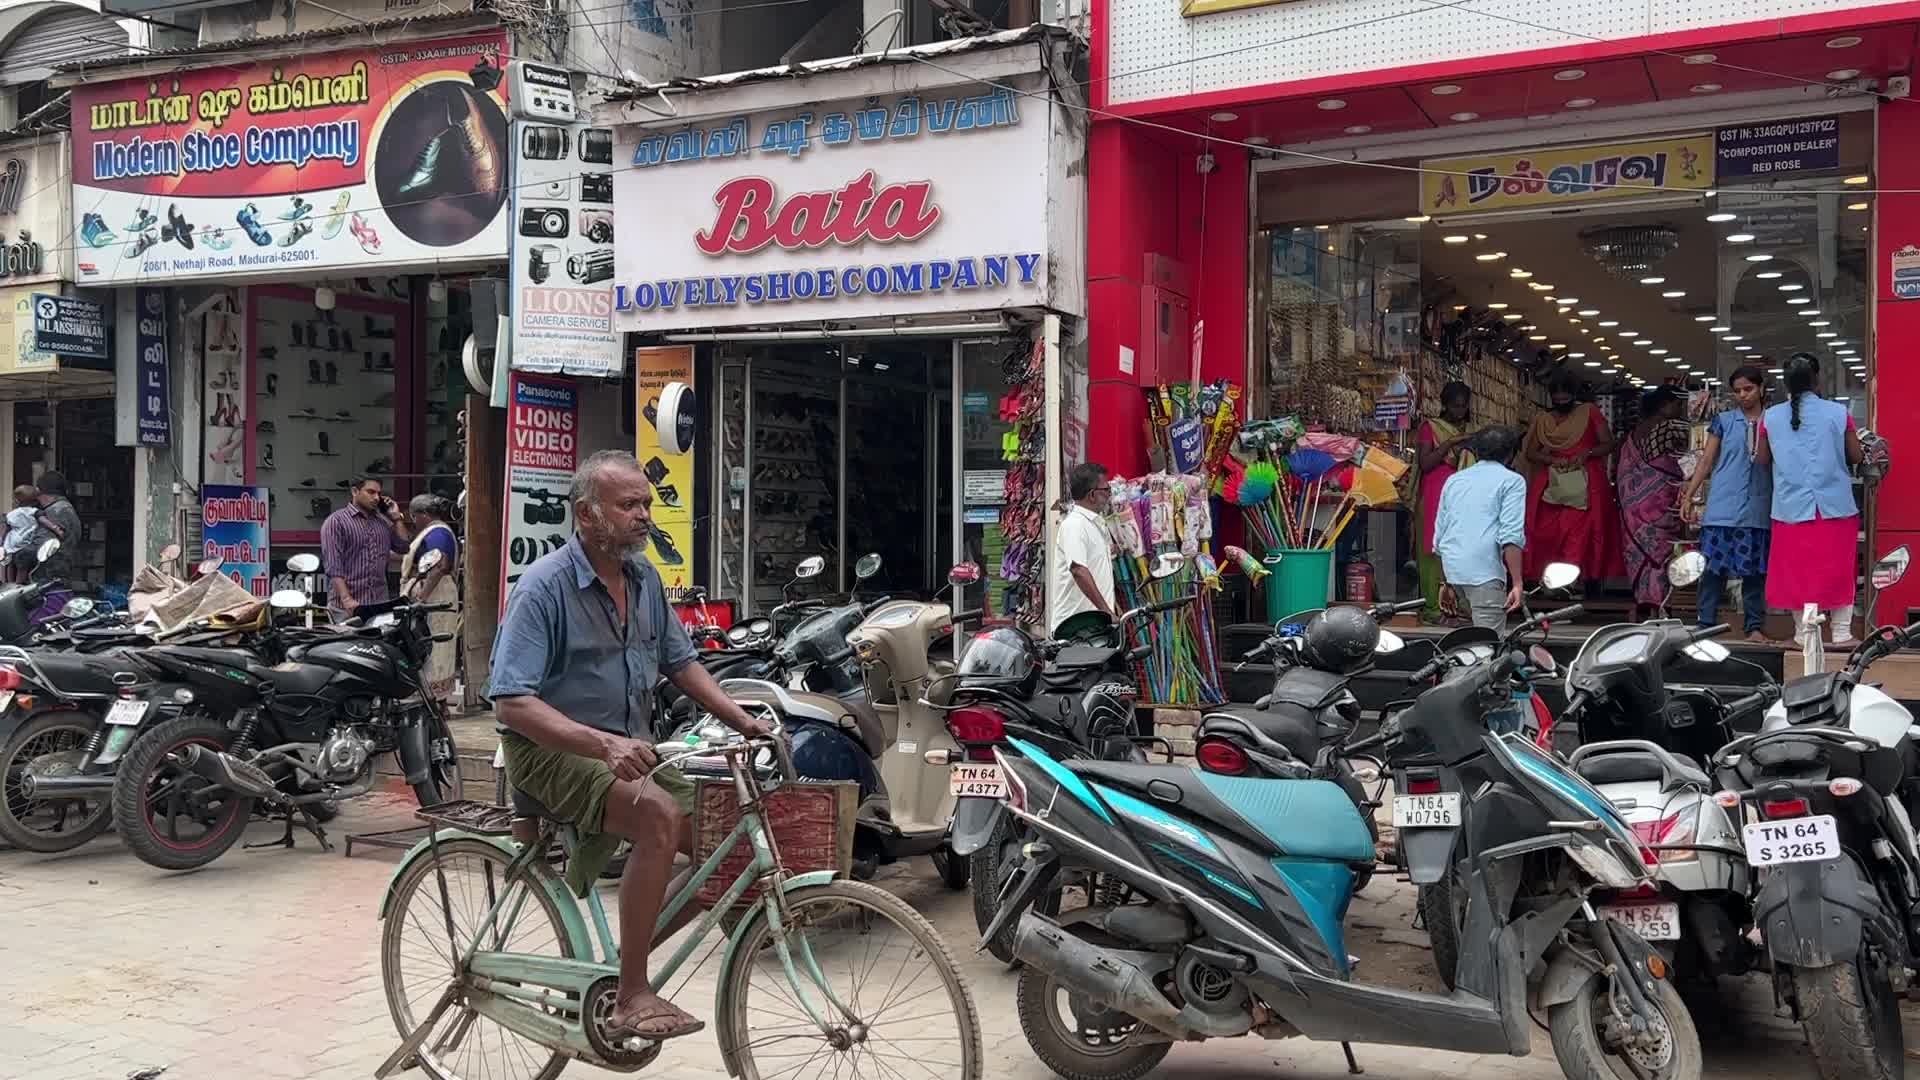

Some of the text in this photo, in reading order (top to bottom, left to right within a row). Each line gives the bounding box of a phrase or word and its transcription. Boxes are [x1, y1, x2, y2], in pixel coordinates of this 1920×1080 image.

[381, 53, 410, 65] GSTIN
[248, 60, 368, 115] கம்பெனி
[1720, 129, 1738, 141] GST
[94, 120, 360, 180] Modern Shoe Company
[1752, 159, 1801, 173] RED ROSE
[694, 169, 942, 256] Bata
[173, 259, 206, 271] Nethaji
[526, 289, 610, 316] LIONS
[526, 315, 608, 329] CAMERA SERVICE
[517, 382, 571, 400] Panasonic
[515, 406, 574, 431] LIONS
[515, 428, 573, 452] VIDEO
[512, 450, 573, 468] ELECTRONICS
[961, 768, 996, 779] TN 64
[956, 783, 1000, 795] J 4377
[1761, 823, 1818, 841] TN 64
[1760, 841, 1826, 861] S 3265
[1615, 906, 1664, 922] TN 64
